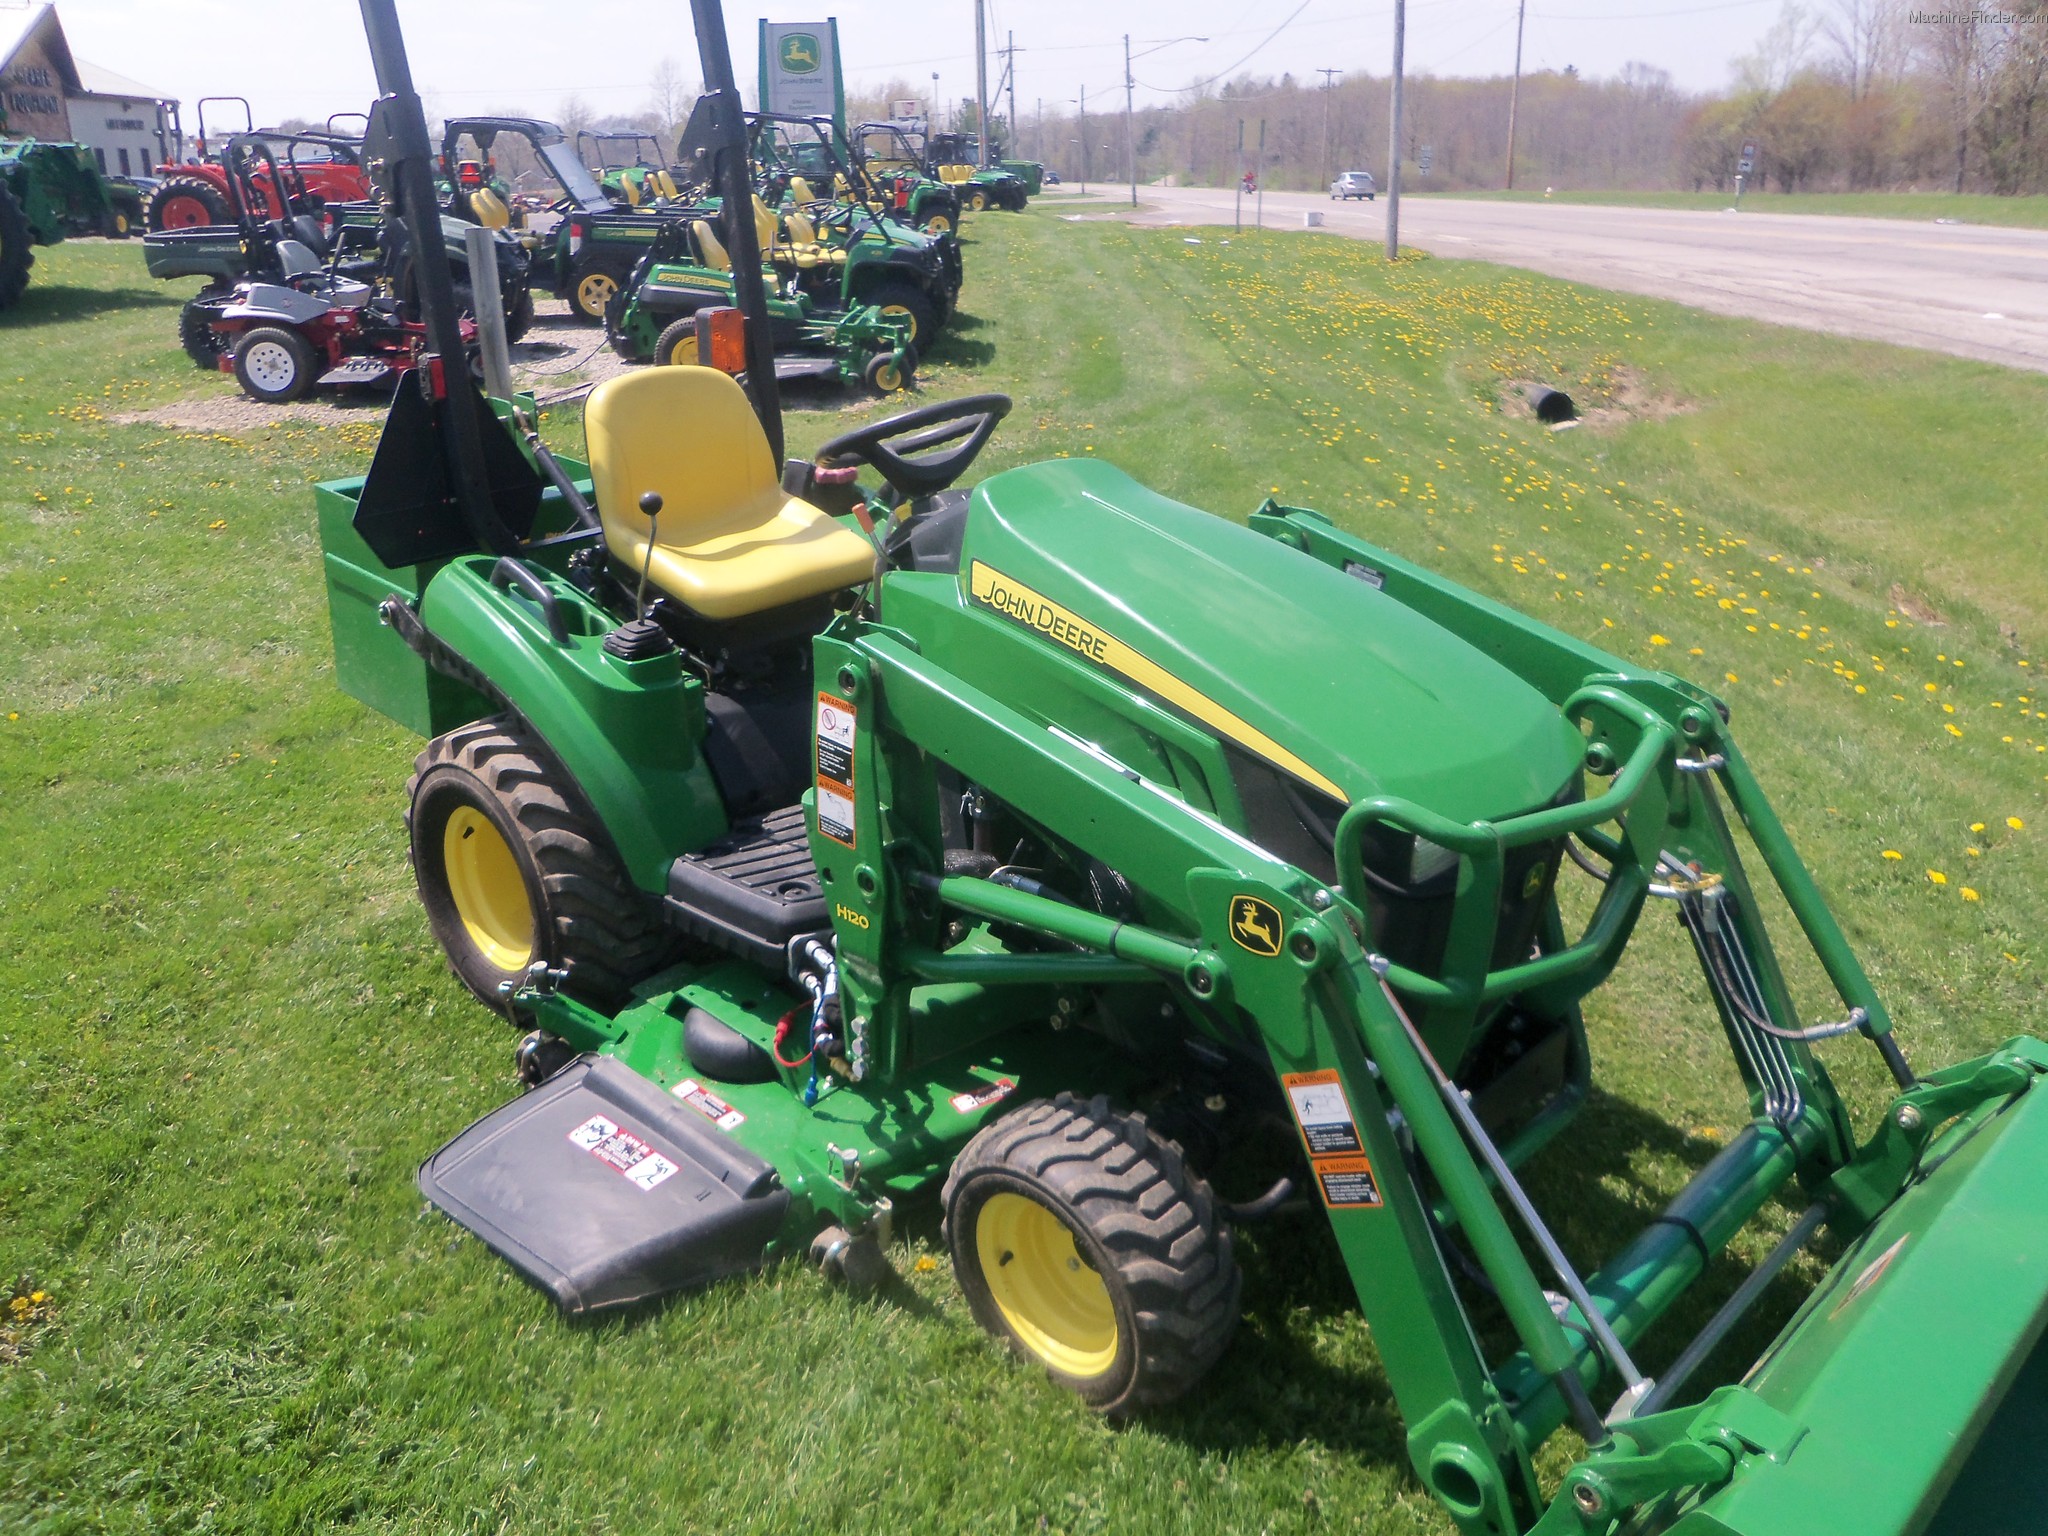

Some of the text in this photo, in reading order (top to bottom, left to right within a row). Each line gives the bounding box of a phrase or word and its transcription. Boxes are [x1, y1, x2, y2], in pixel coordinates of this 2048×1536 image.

[663, 274, 709, 285] JOHN DEERE
[982, 580, 1107, 661] JOHN DEERE
[825, 696, 856, 714] WARNING
[823, 782, 853, 800] WARNING
[836, 903, 870, 929] H120
[1298, 1073, 1332, 1083] WARNING
[1329, 1162, 1364, 1170] WARNING
